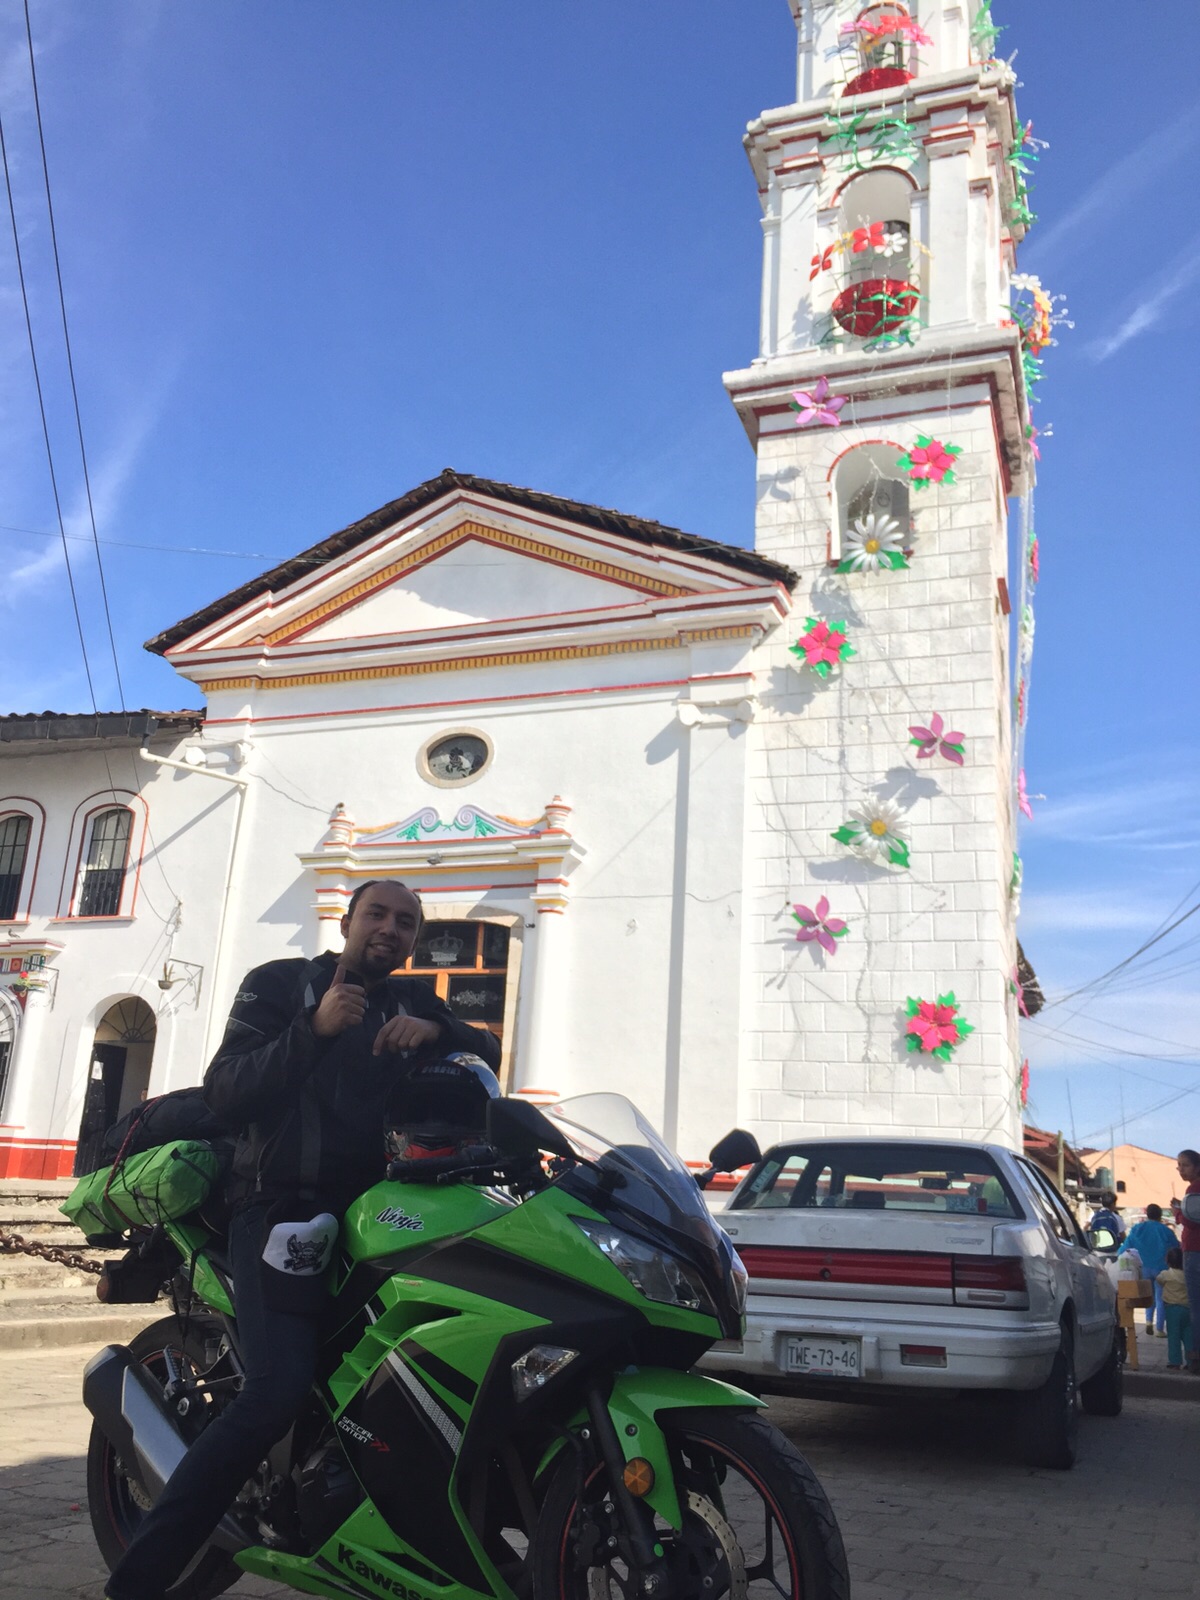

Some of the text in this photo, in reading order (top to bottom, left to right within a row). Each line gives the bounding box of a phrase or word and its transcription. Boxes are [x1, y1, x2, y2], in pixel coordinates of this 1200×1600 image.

[375, 1206, 424, 1231] Ninja
[788, 1346, 856, 1368] TWE-73-46
[338, 1420, 368, 1443] EDITION
[342, 1415, 374, 1441] SPECIAL
